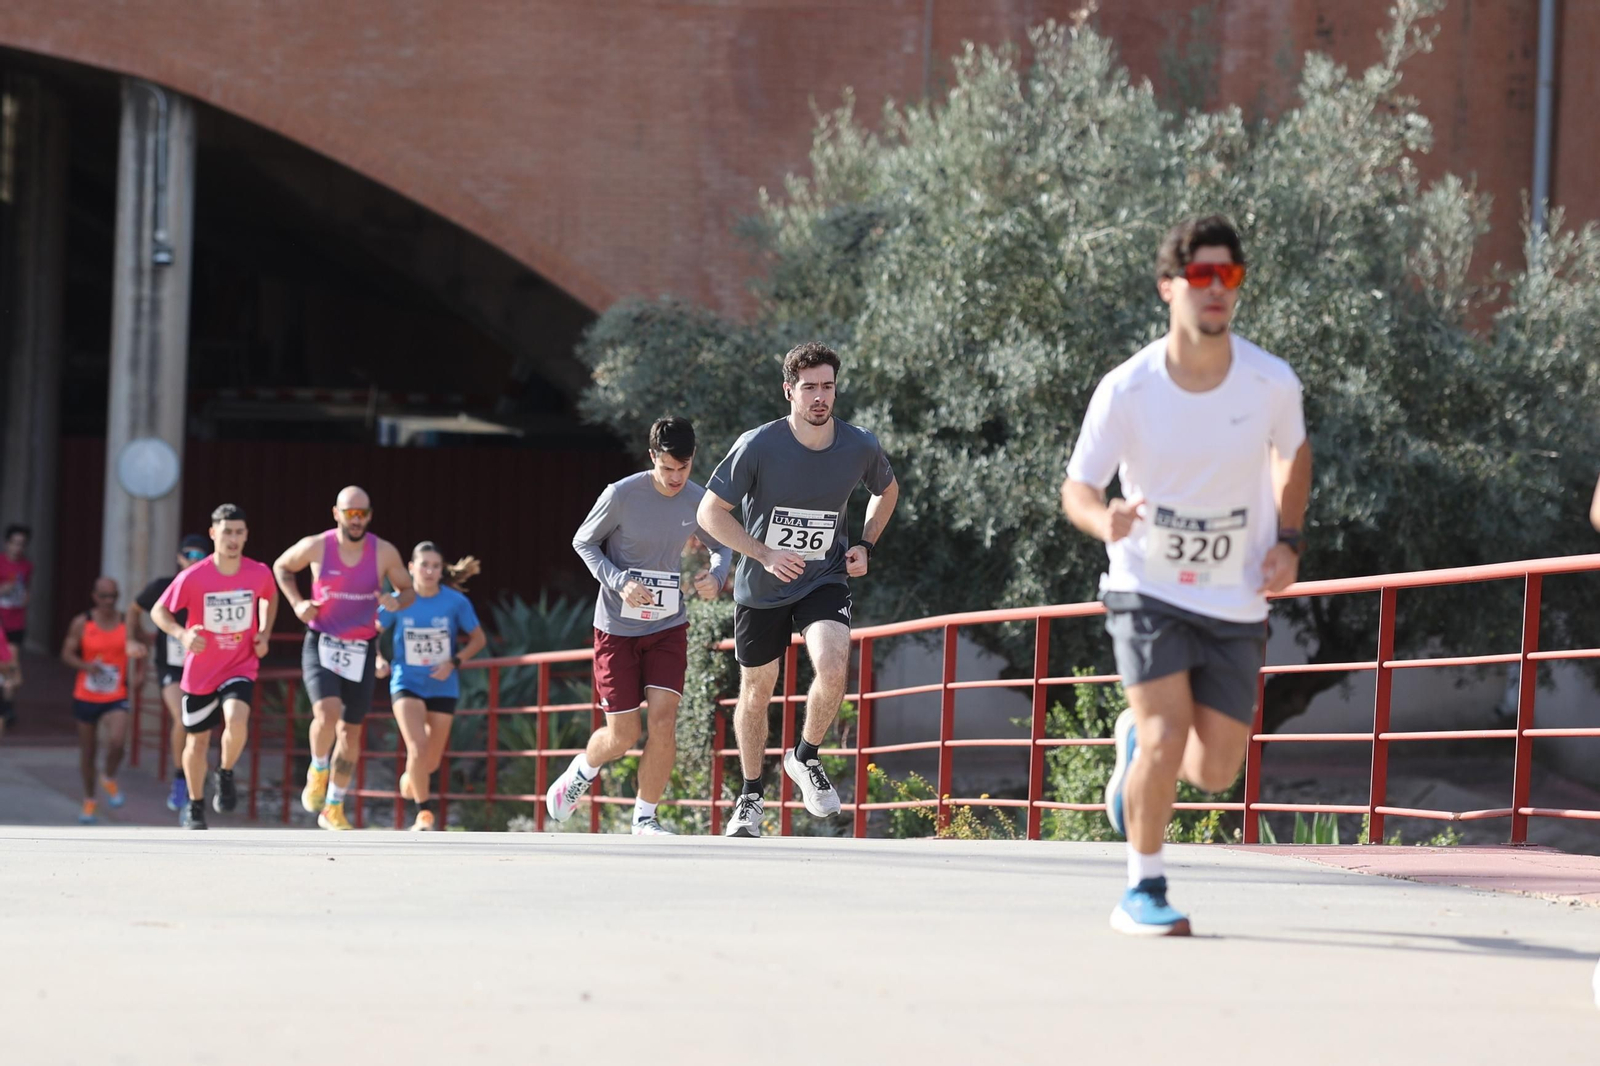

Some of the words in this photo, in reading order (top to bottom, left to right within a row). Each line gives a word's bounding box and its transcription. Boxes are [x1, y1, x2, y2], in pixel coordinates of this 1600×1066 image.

[774, 515, 803, 527] UMA
[777, 528, 824, 550] 236
[1166, 533, 1231, 562] 320
[213, 606, 245, 622] 310
[413, 641, 443, 655] 443
[331, 651, 352, 667] 45
